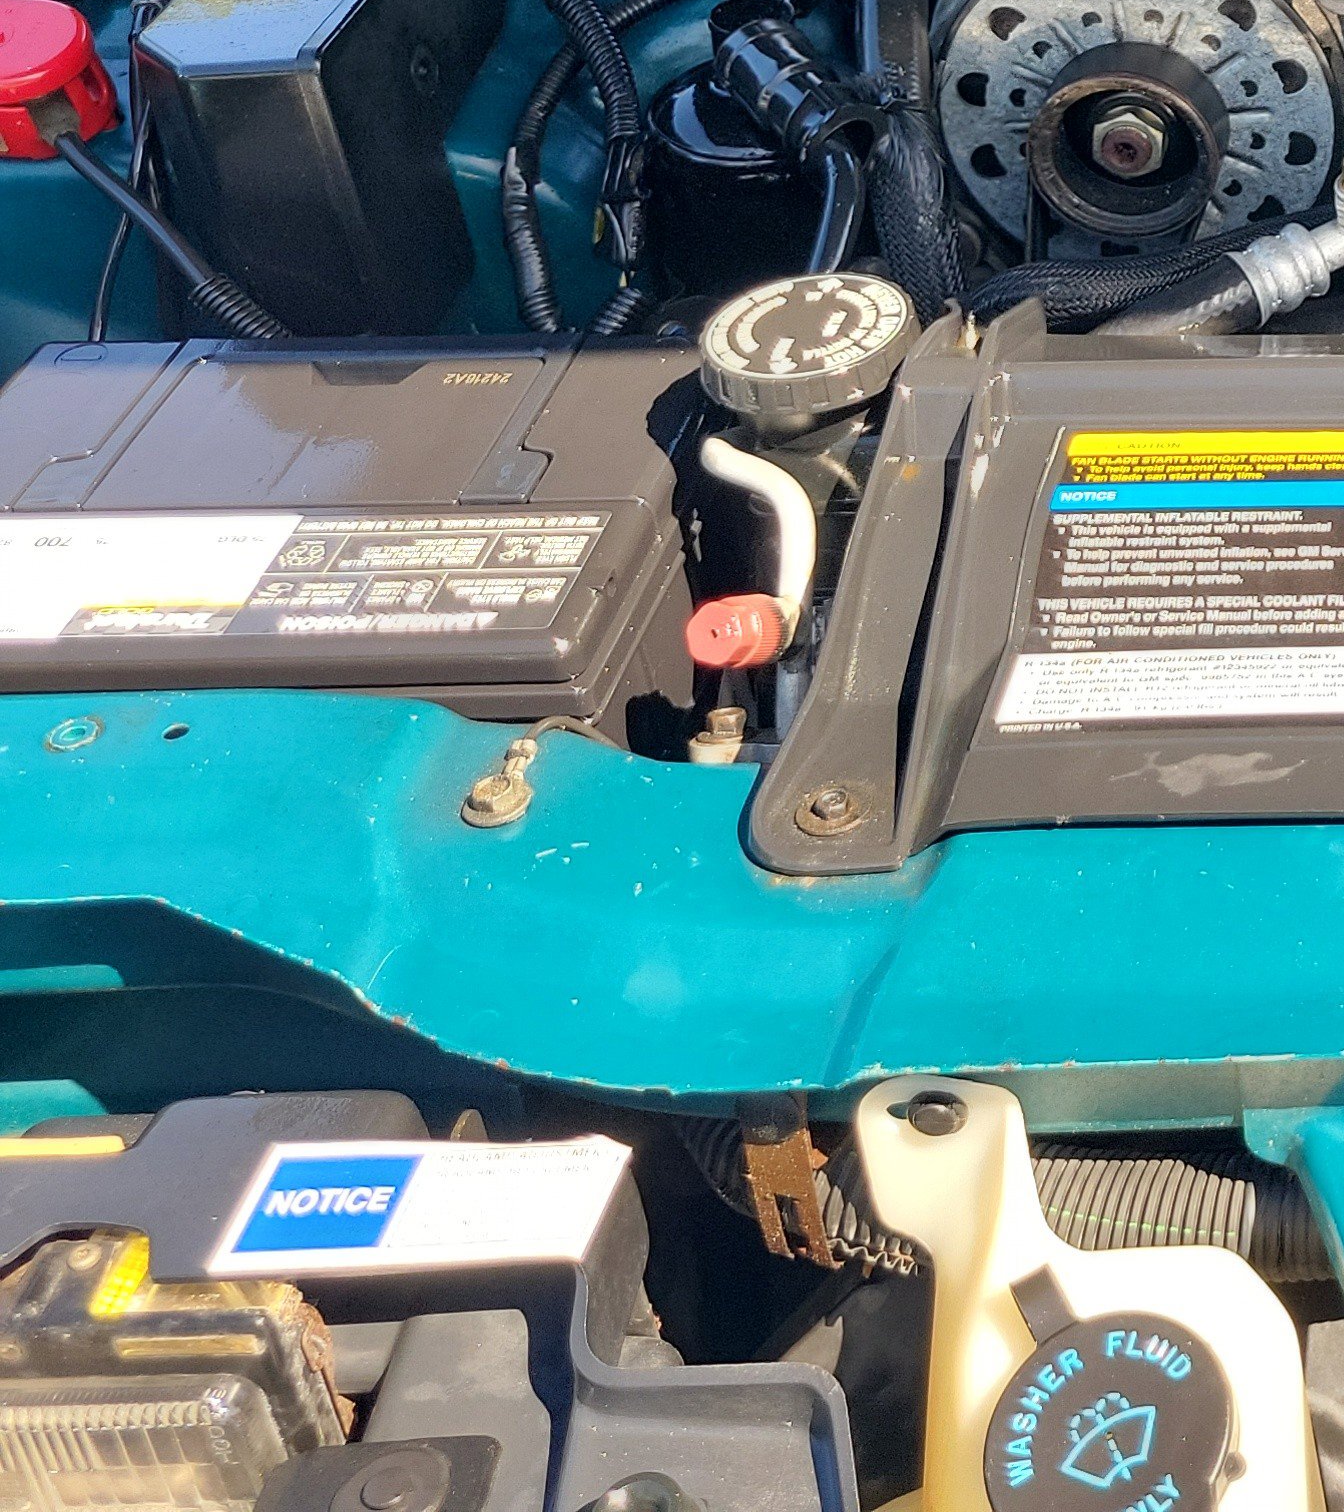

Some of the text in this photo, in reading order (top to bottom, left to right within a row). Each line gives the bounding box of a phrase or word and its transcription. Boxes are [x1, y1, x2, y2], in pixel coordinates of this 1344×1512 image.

[1072, 457, 1098, 466] FAN
[1099, 456, 1139, 465] BLADE
[1141, 456, 1188, 464] STARTS
[1190, 455, 1248, 464] WITHOUT
[1249, 455, 1297, 463] ENGINE
[1091, 465, 1103, 473] To
[1105, 465, 1130, 474] help
[1132, 464, 1165, 473] avoid
[1166, 464, 1217, 473] personal
[1219, 463, 1254, 472] injury,
[1256, 463, 1285, 472] keep
[1287, 462, 1323, 470] hands
[1086, 473, 1107, 482] Fan
[1109, 473, 1142, 482] blade
[1168, 473, 1197, 481] start
[1212, 473, 1234, 482] any
[1236, 471, 1265, 480] time.
[1060, 489, 1117, 503] NOTICE
[1054, 511, 1304, 524] SUPPLEMENTAL INFLATABLE RESTRAINT.
[1071, 525, 1097, 535] This
[1098, 525, 1142, 535] vehicle
[1143, 525, 1154, 534] is
[1156, 524, 1212, 536] equipped
[1214, 524, 1240, 534] with
[1252, 522, 1333, 534] supplemental
[34, 536, 73, 547] 700
[1068, 536, 1225, 547] inflatable restraint system.
[1066, 549, 1081, 559] To
[1082, 549, 1110, 560] help
[1111, 549, 1157, 560] prevent
[1159, 548, 1219, 559] unwanted
[1220, 547, 1272, 558] inflation,
[1274, 548, 1296, 557] see
[1297, 547, 1320, 557] GM
[1063, 559, 1335, 572] Manual for diagnostic and service procedures
[1061, 574, 1244, 587] before performing any service.
[1038, 598, 1068, 610] THIS
[1069, 598, 1125, 609] VEHICLE
[1126, 597, 1193, 608] REQUIRES
[1194, 596, 1205, 608] A
[1206, 596, 1261, 607] SPECIAL
[1262, 595, 1327, 607] COOLANT
[1055, 612, 1089, 623] Read
[1090, 611, 1141, 623] Owner's
[1142, 612, 1157, 622] or
[1157, 610, 1204, 622] Service
[1205, 610, 1252, 621] Manual
[1253, 609, 1292, 620] before
[1294, 608, 1336, 620] adding
[1053, 627, 1095, 637] Failure
[1097, 626, 1110, 636] to
[1112, 626, 1150, 636] follow
[1151, 624, 1196, 637] special
[1197, 624, 1213, 635] fill
[1214, 623, 1277, 636] procedure
[1278, 623, 1314, 633] could
[1051, 639, 1096, 650] engine.
[1071, 653, 1336, 667] (FOR AIR CONDITIONED VEHICLES ONLY)
[1000, 724, 1042, 733] PRINTED
[1043, 723, 1053, 731] IN
[265, 1186, 395, 1215] NOTICE
[1004, 1330, 1193, 1488] WASHER FLUID
